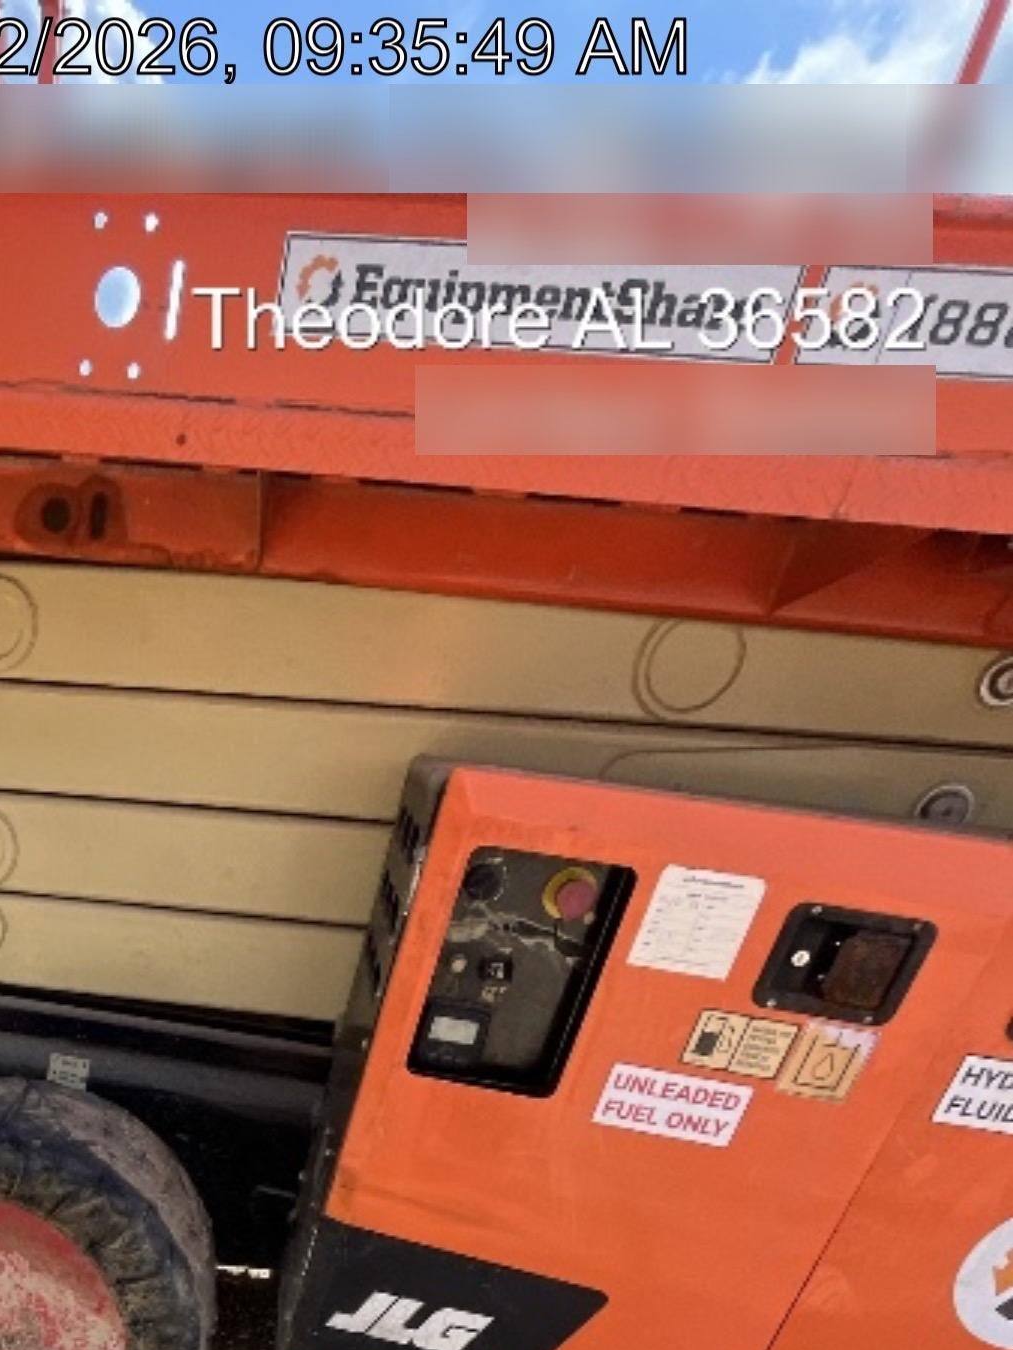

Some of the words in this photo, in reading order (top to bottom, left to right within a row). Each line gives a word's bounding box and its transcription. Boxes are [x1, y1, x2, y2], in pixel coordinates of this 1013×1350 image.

[613, 1072, 741, 1111] UNLEADED
[601, 1099, 657, 1126] FUEL
[666, 1112, 730, 1137] ONLY
